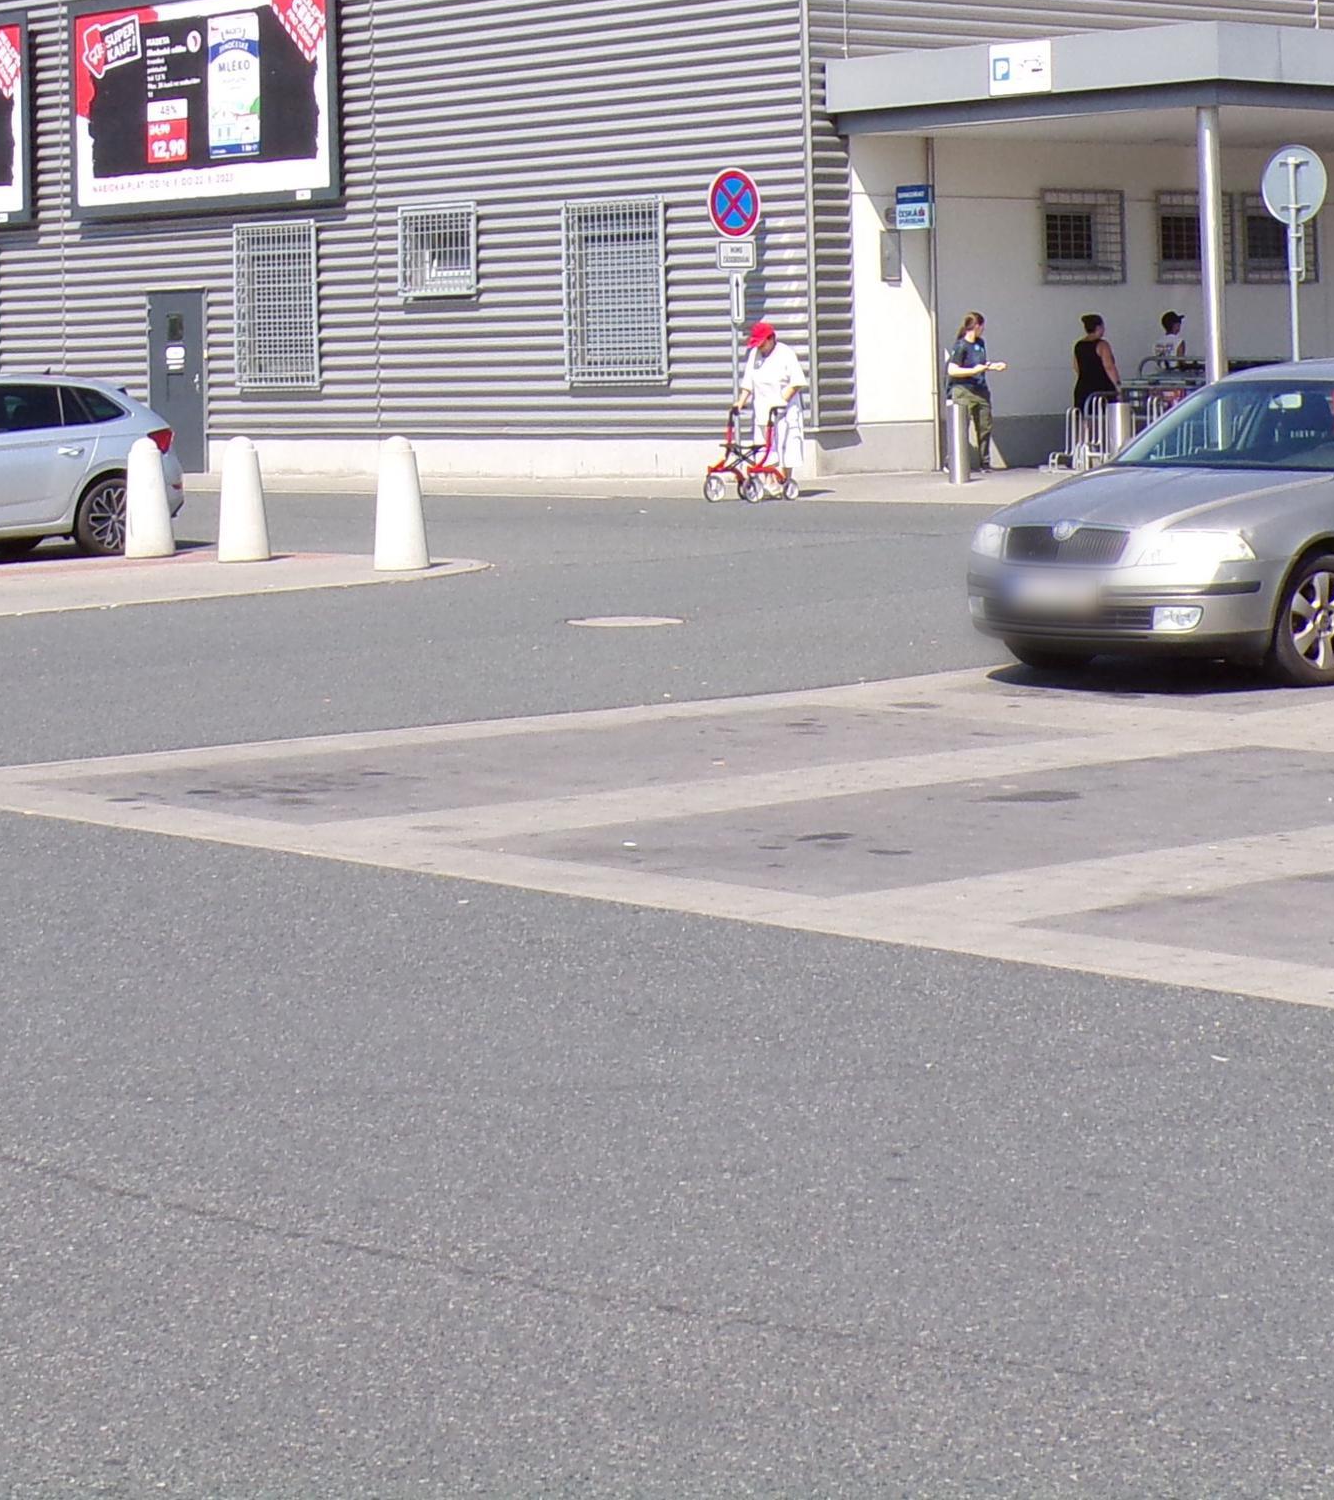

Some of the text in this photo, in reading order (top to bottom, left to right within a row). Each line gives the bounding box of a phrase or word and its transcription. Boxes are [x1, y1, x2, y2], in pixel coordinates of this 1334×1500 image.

[104, 23, 135, 48] SUPER
[107, 38, 137, 62] KAUF!
[218, 60, 251, 73] MLÉKO
[152, 139, 186, 159] 12,90
